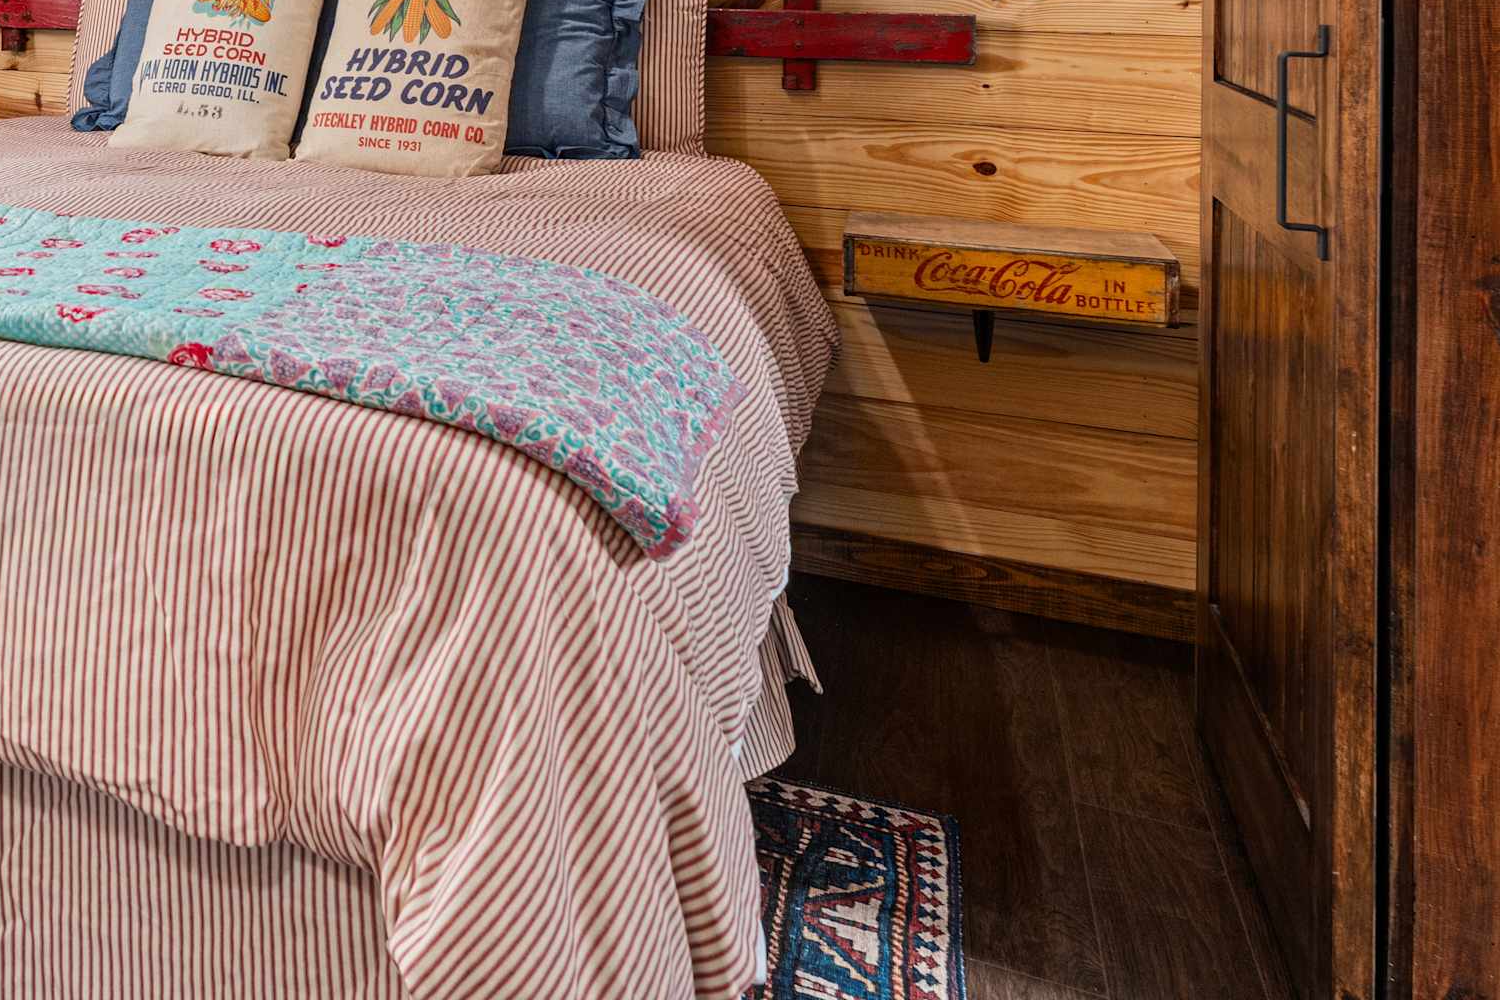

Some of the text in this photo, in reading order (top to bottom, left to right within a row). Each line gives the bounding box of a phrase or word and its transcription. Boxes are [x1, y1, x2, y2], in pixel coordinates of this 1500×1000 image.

[176, 27, 254, 48] HYBRID
[163, 43, 267, 66] SEED CORN
[346, 47, 470, 80] HYBRID
[139, 58, 288, 97] VAN HORN HYBRIDS INC.
[152, 81, 260, 104] CERRO GORDO, ILL.
[320, 75, 494, 116] SEED CORN
[312, 111, 487, 145] STECKLEY HYBRID CORN CO.
[358, 136, 422, 153] SINCE 1931
[858, 243, 1126, 306] DRINK Coca-Cola IN
[1075, 294, 1157, 315] BOTTLES
